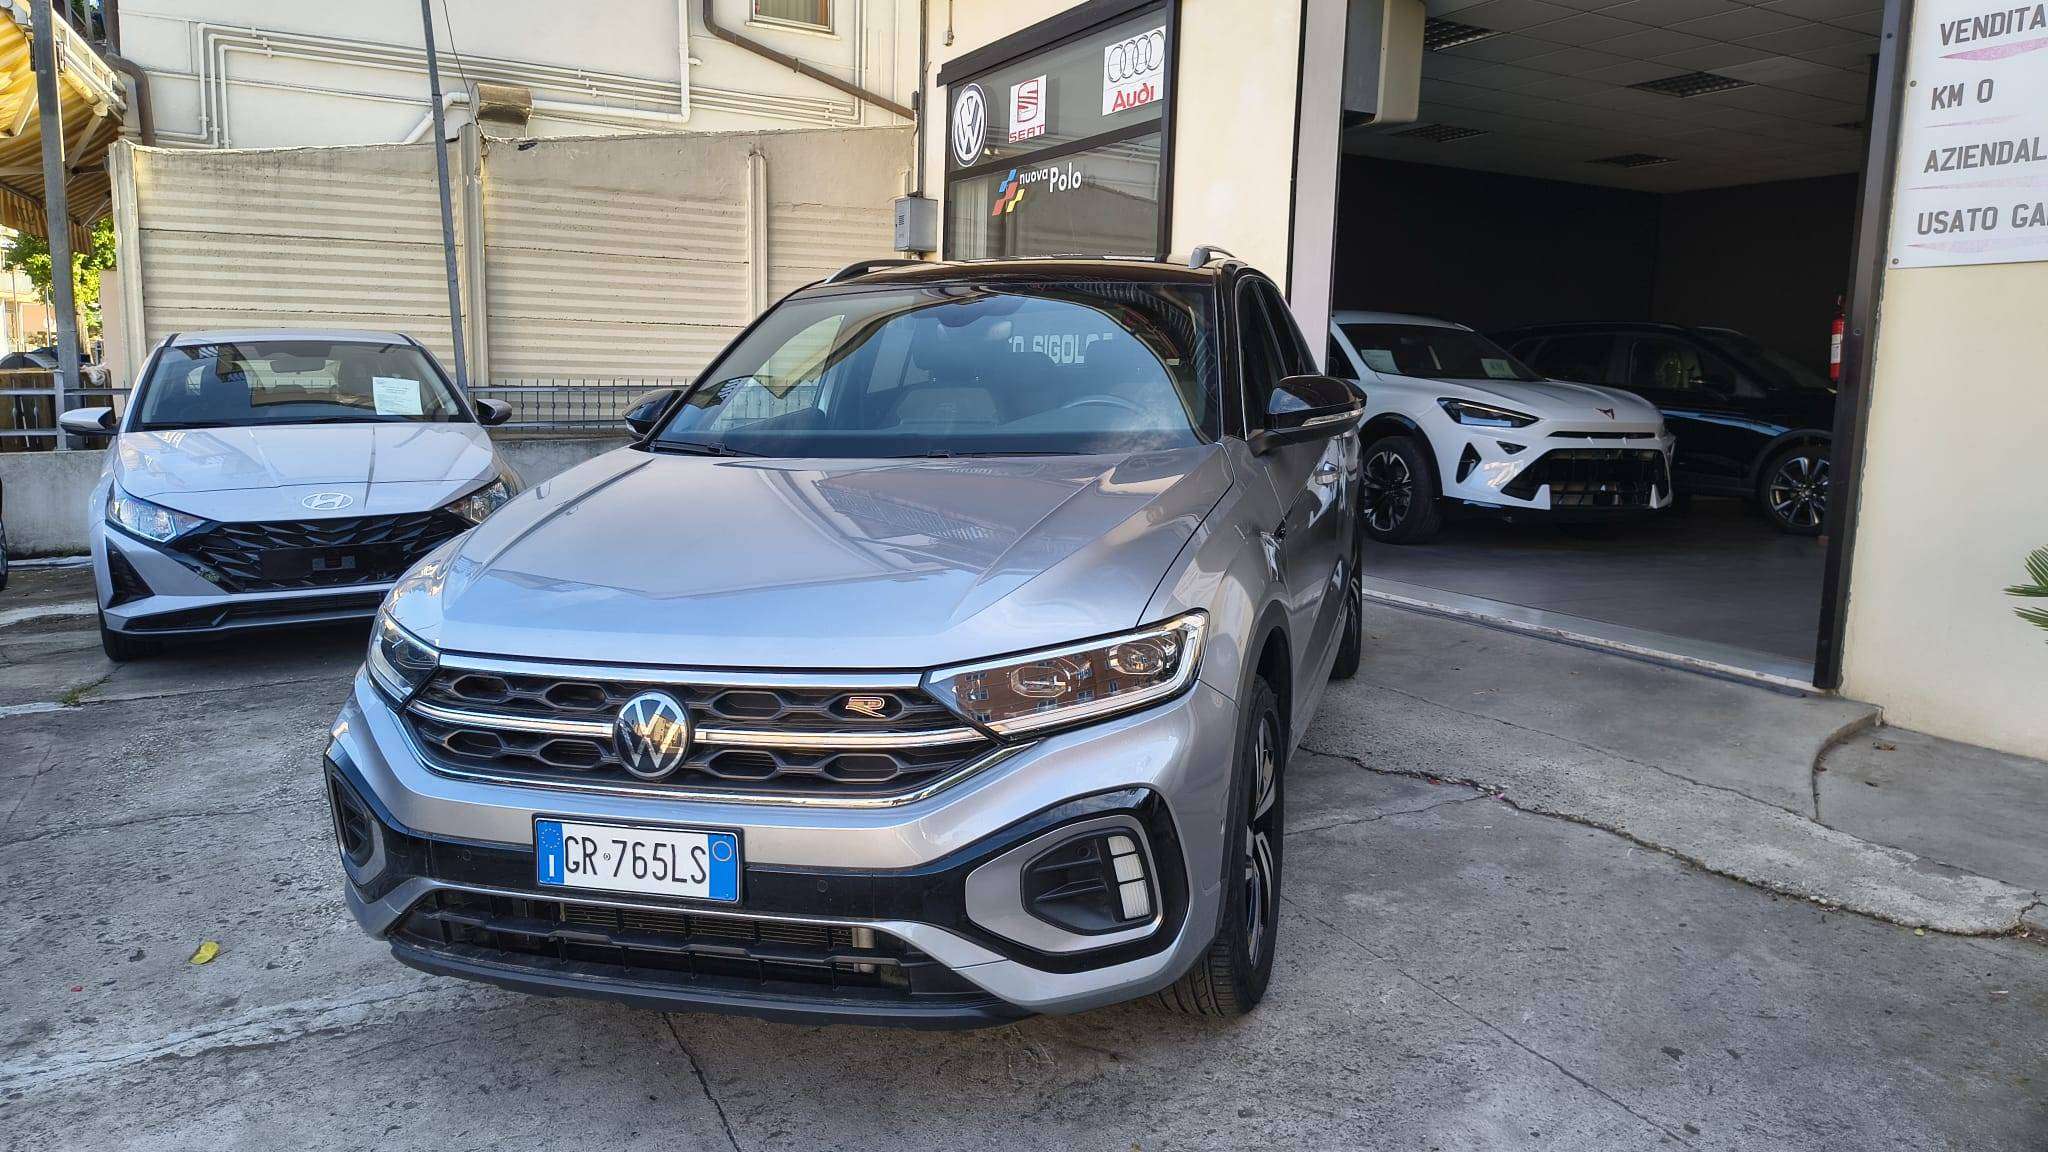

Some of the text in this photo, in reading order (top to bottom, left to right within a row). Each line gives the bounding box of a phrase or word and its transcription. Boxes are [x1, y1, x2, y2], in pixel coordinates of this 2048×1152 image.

[1940, 4, 2046, 46] VENDITA
[1112, 83, 1154, 112] Audi
[1931, 83, 1964, 110] KM
[1009, 124, 1045, 143] SEAT
[1020, 162, 1082, 192] nuova Polo
[1917, 202, 2048, 235] USATO GA
[564, 835, 598, 875] GR
[611, 839, 707, 884] 765LS
